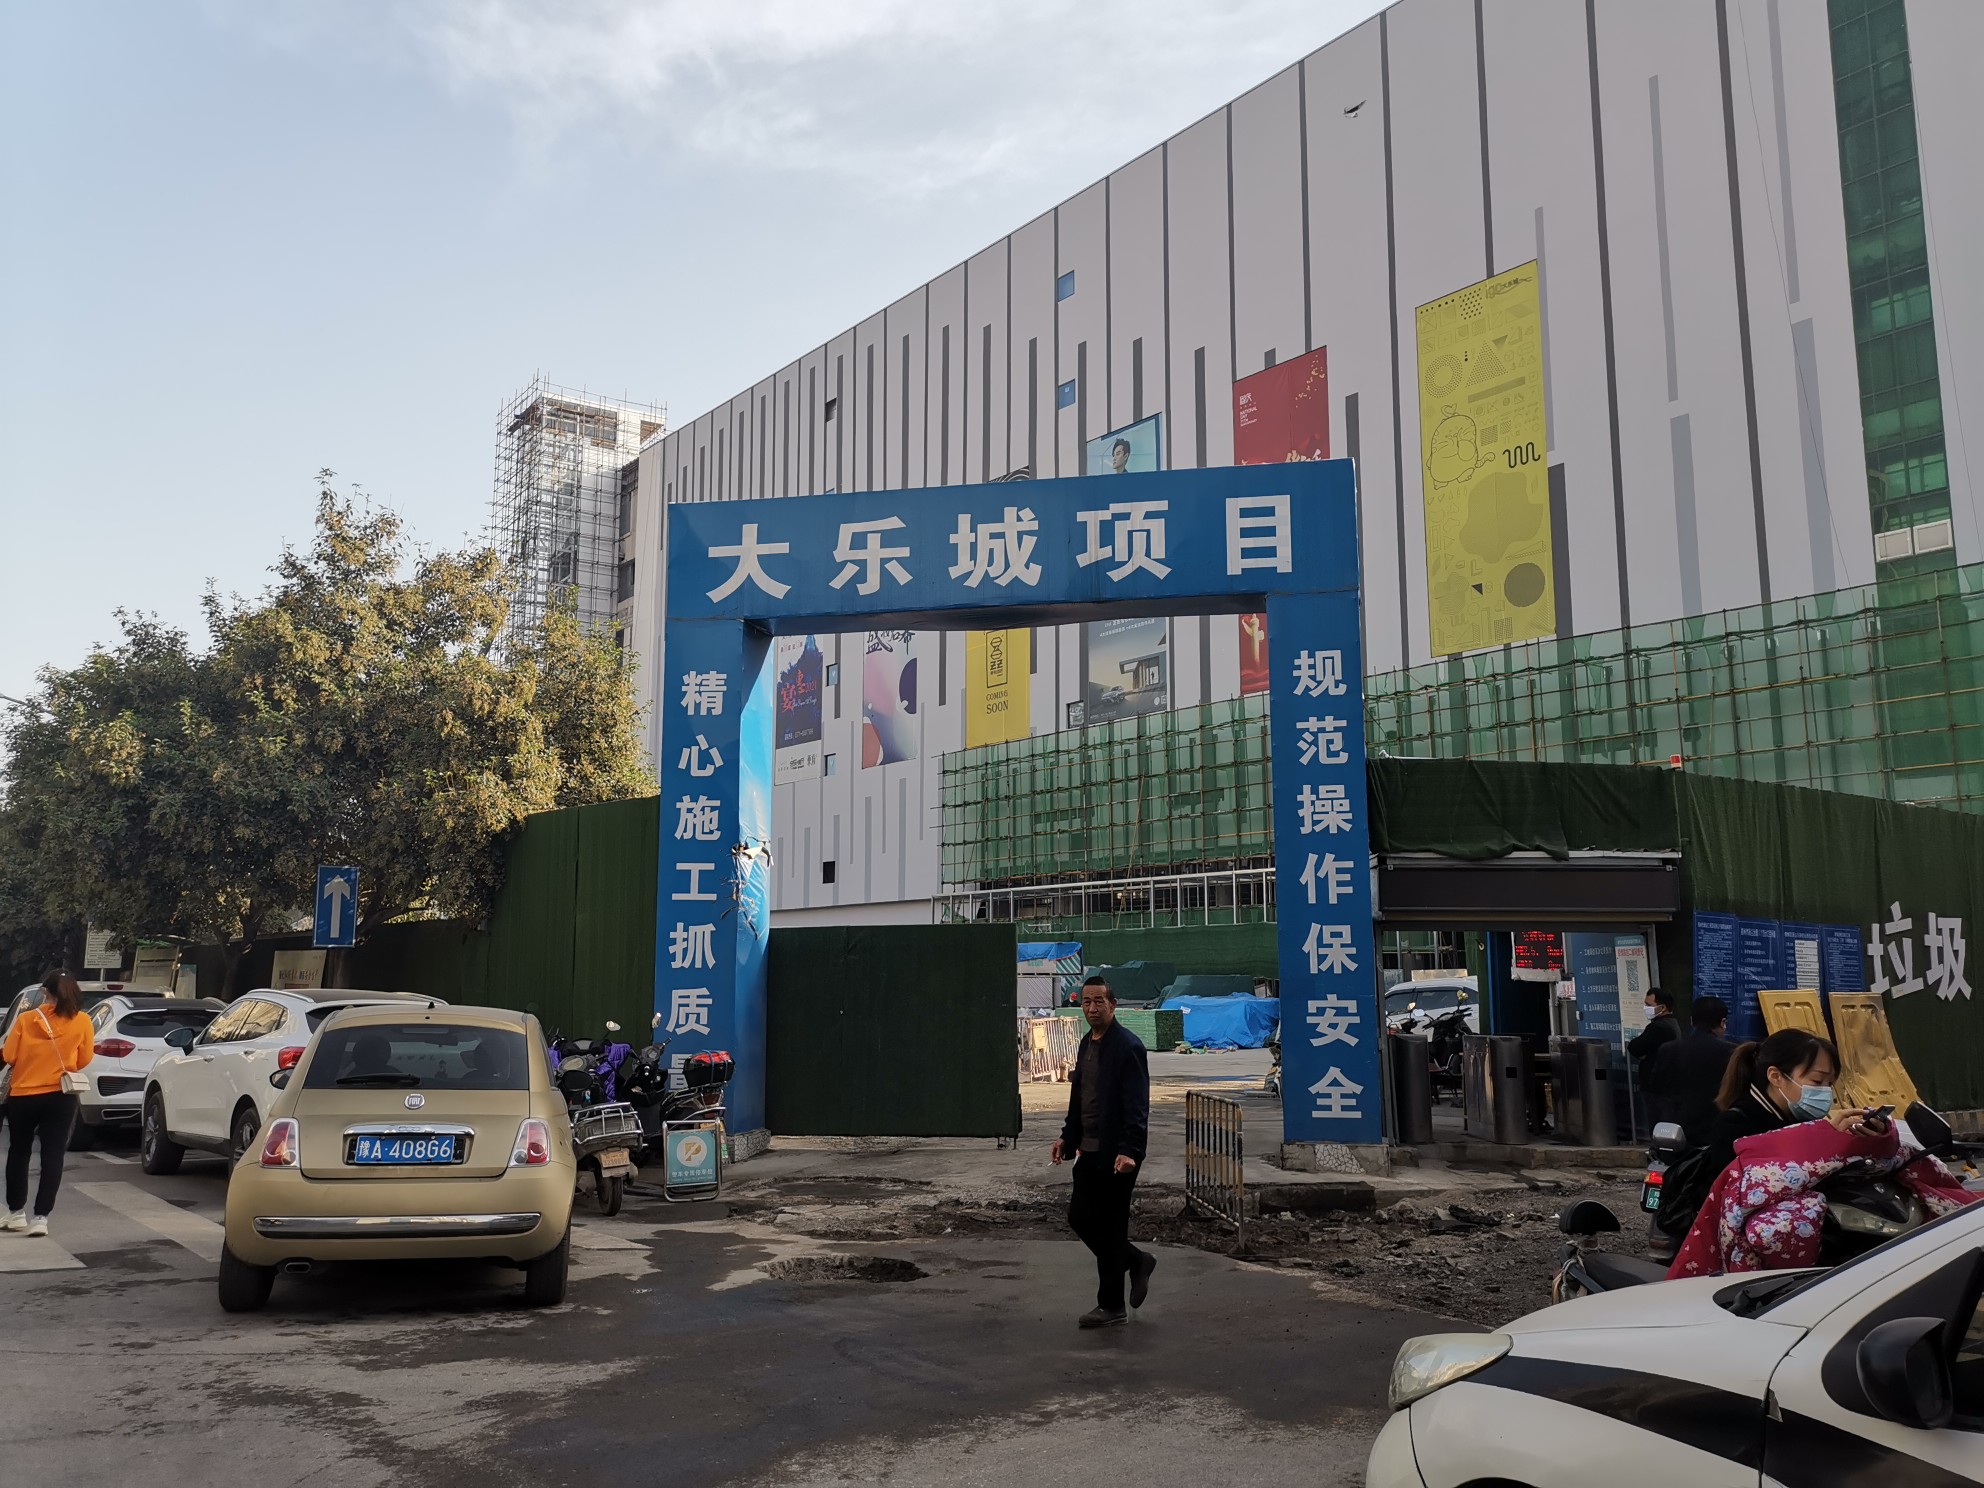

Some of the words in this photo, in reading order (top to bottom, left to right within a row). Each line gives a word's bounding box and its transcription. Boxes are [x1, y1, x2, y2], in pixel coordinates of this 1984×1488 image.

[706, 494, 1294, 603] 大乐城项目
[986, 690, 1008, 701] COMING
[986, 700, 1009, 714] SOON
[1292, 649, 1364, 1119] 规范操作保安全
[1867, 901, 1973, 1002] 垃圾
